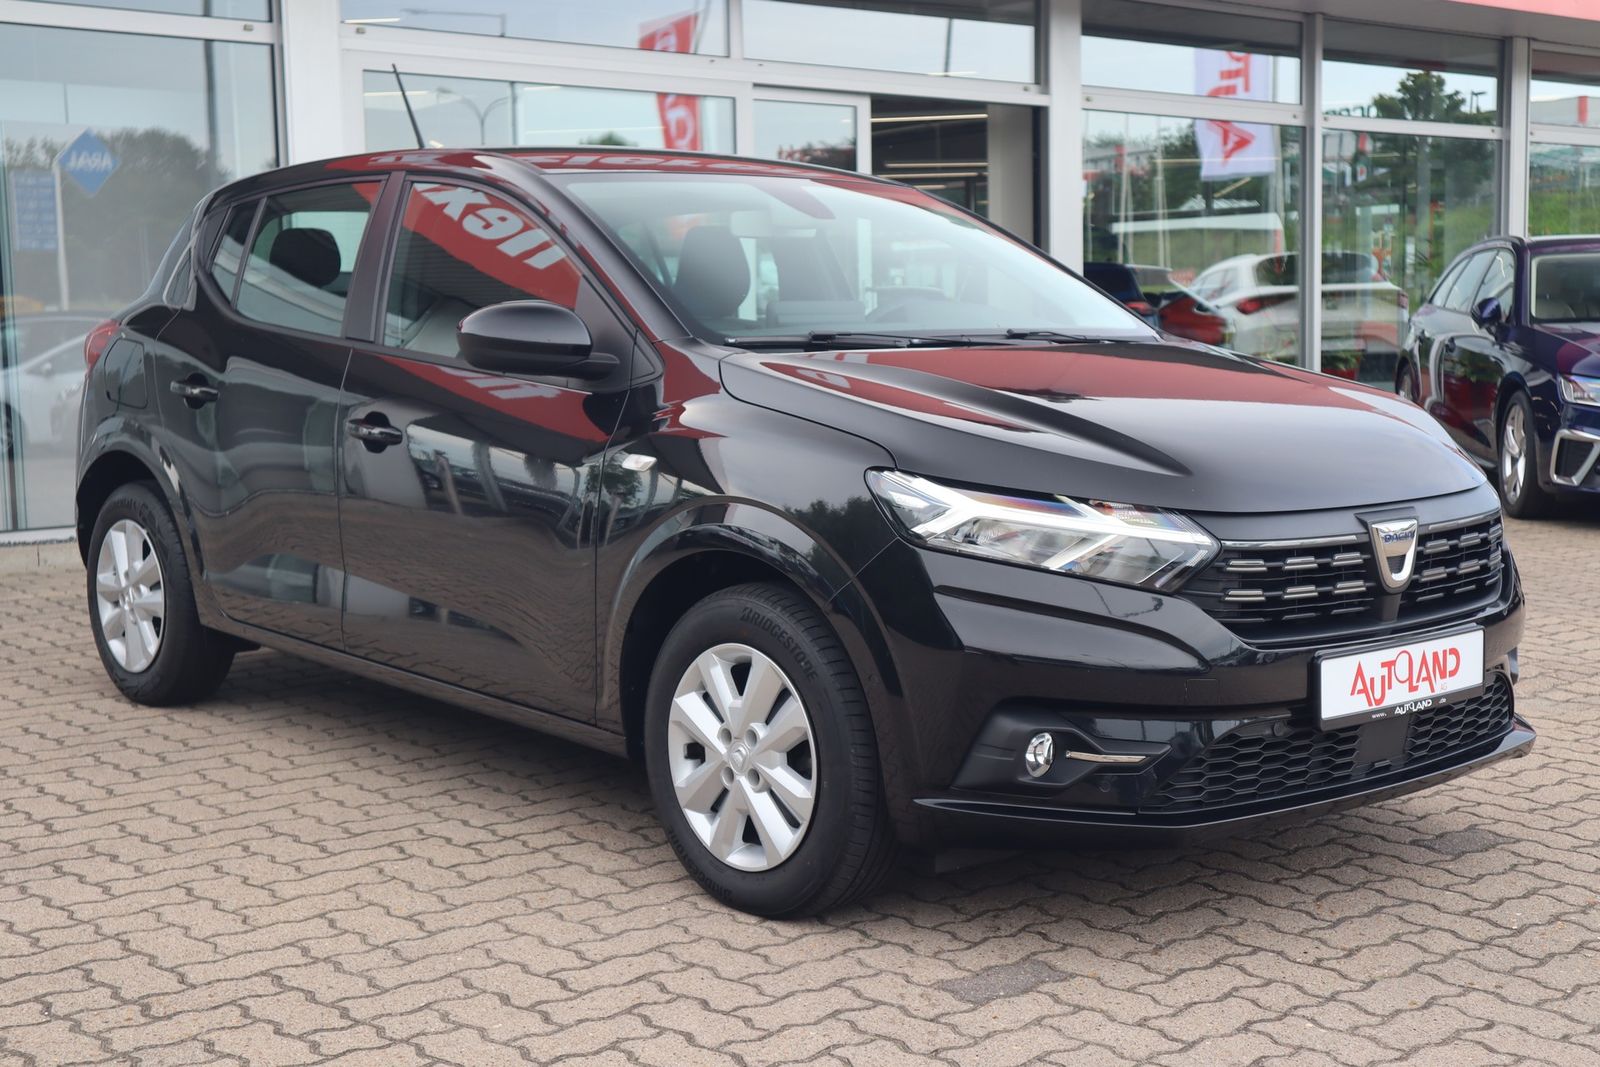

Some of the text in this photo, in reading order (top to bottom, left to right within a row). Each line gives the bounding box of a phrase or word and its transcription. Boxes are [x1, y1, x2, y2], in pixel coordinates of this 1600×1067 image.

[740, 606, 818, 682] BRIDGESTONE
[1350, 647, 1461, 707] AUTOLAND
[1395, 699, 1432, 715] AUTOLAND
